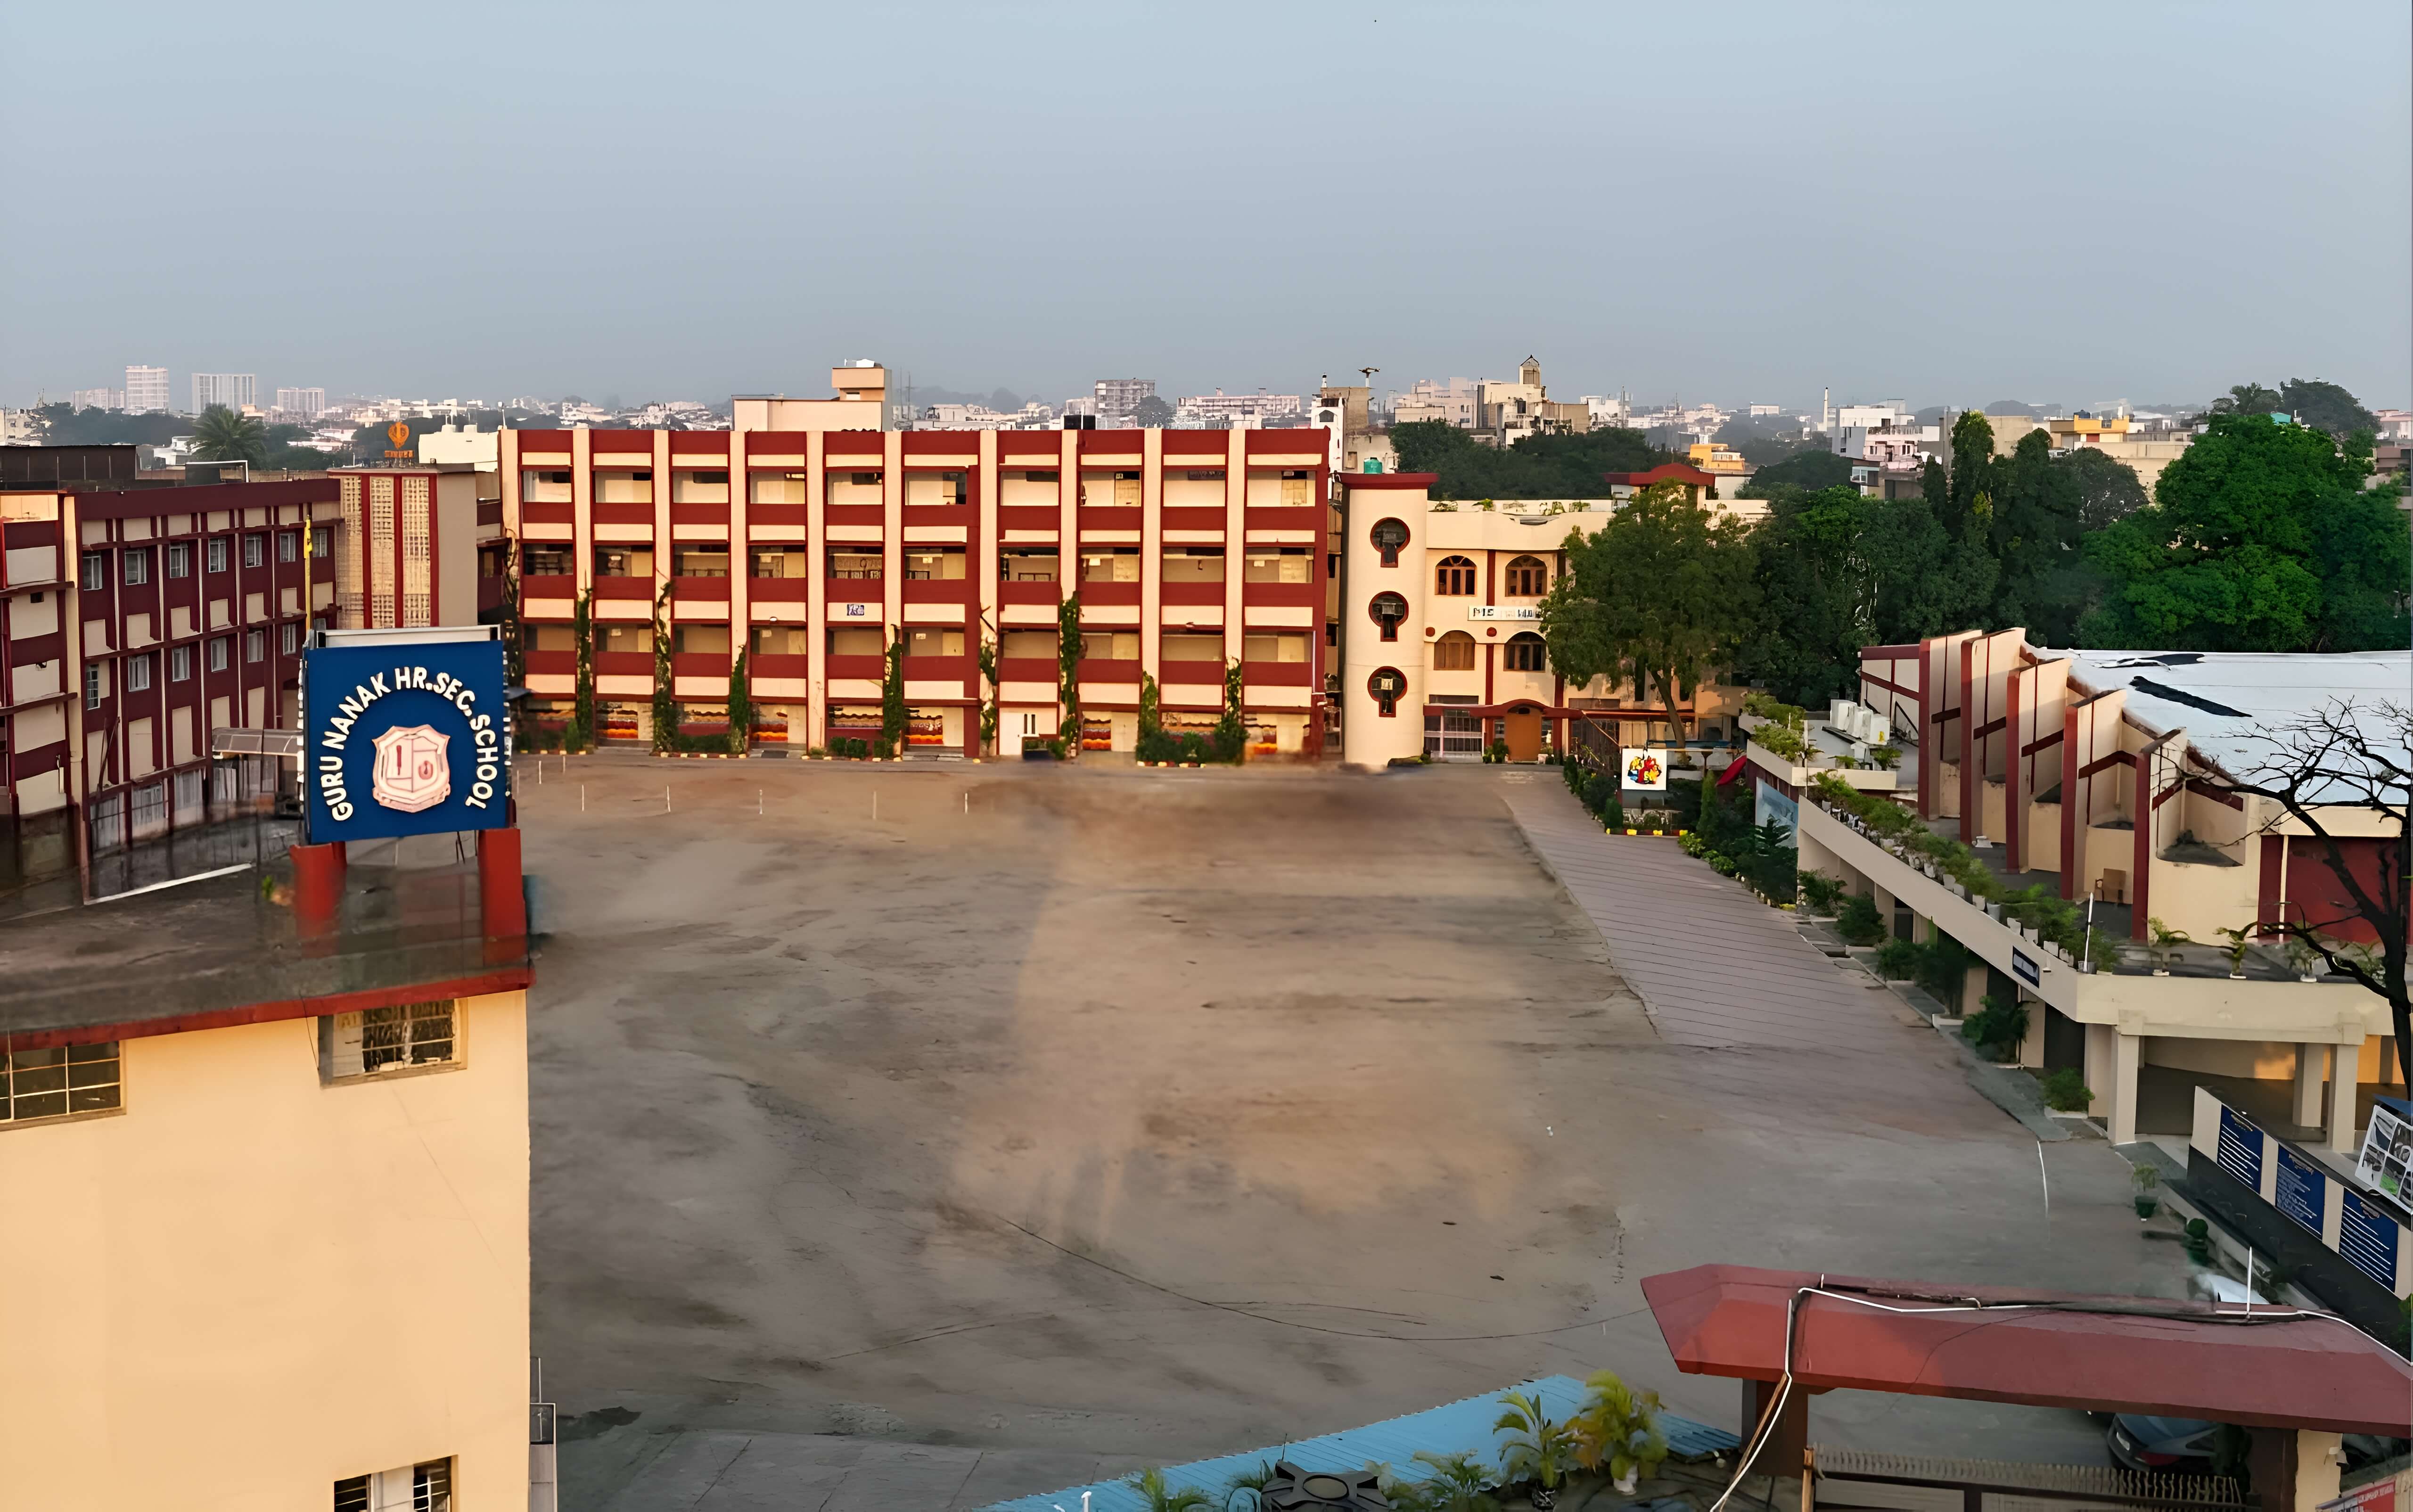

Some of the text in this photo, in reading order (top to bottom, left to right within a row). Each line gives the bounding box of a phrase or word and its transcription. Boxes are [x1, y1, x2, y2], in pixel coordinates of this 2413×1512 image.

[321, 672, 392, 750] NANAK
[319, 756, 353, 821] GURU
[465, 714, 499, 809] SCHOOL
